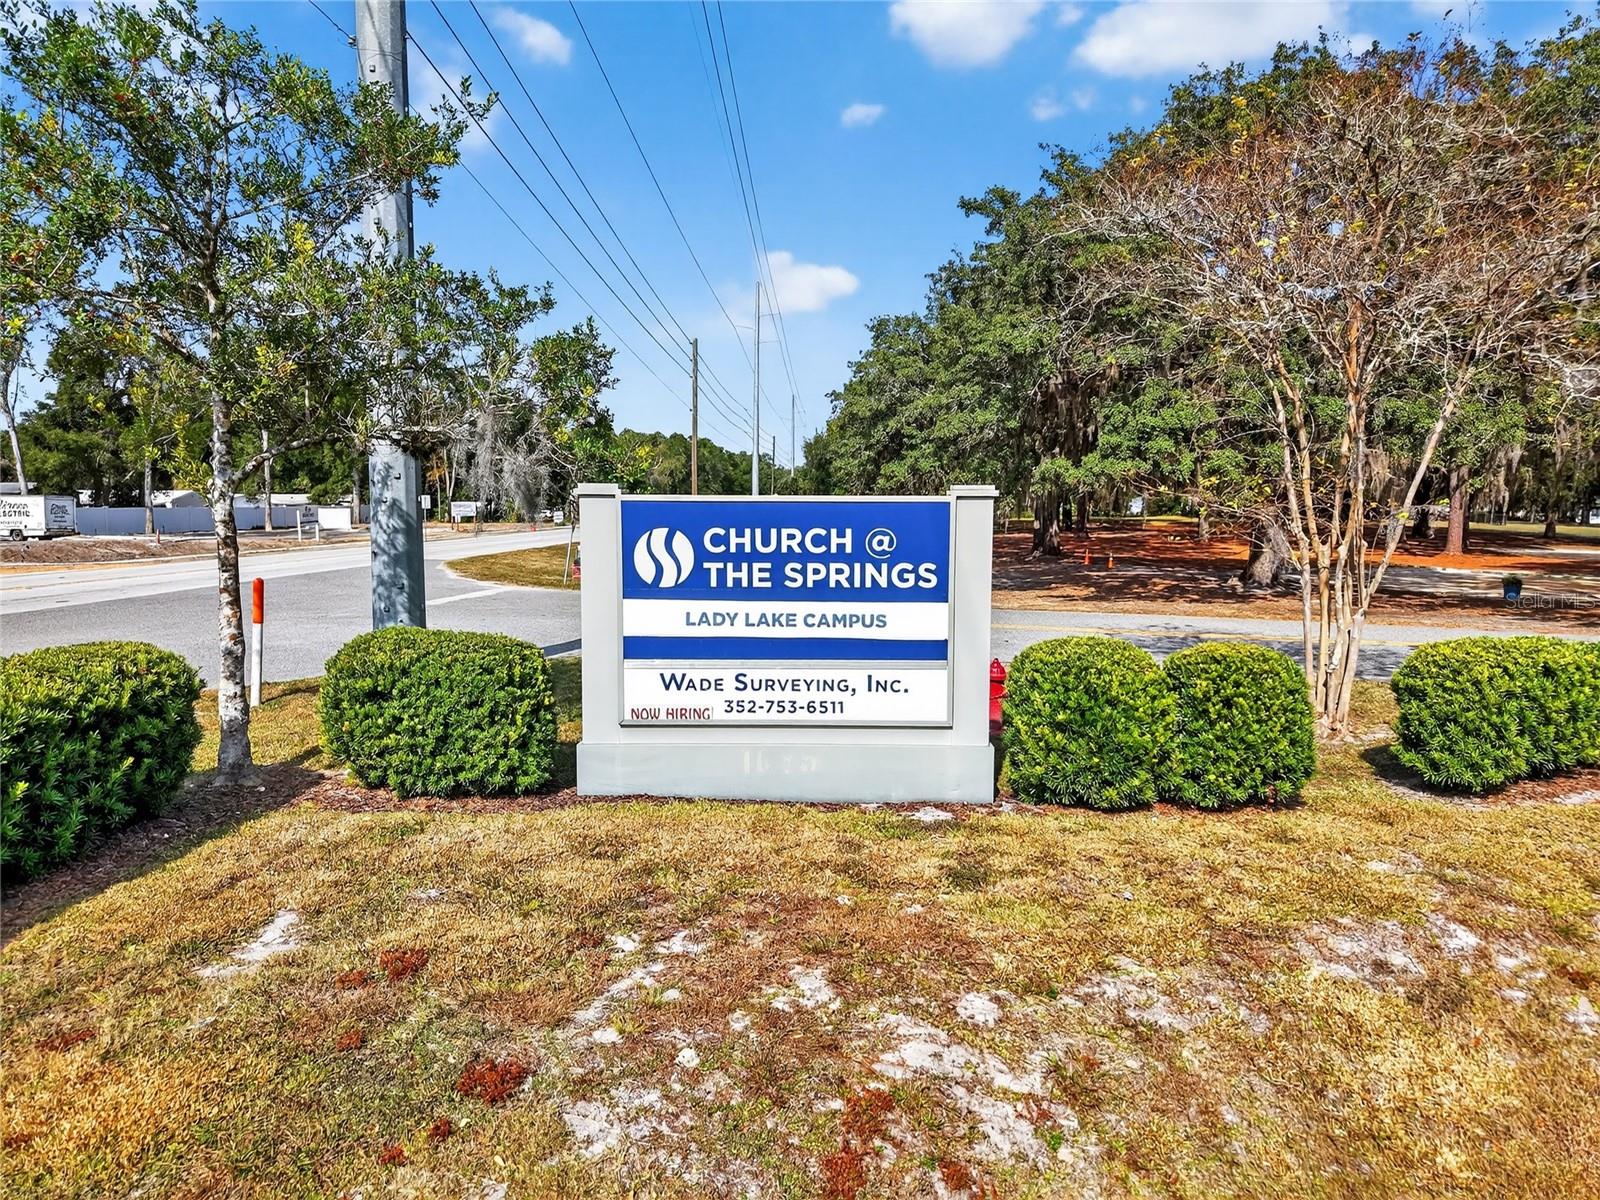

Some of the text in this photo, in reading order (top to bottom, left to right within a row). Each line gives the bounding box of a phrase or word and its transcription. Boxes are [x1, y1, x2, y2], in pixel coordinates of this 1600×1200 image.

[703, 527, 897, 559] CHURCH @
[703, 562, 938, 589] THE SPRINGS
[685, 612, 887, 629] LADY LAKE CAMPUS
[631, 708, 710, 720] NOW HIRING
[724, 700, 844, 714] 352-753-6511
